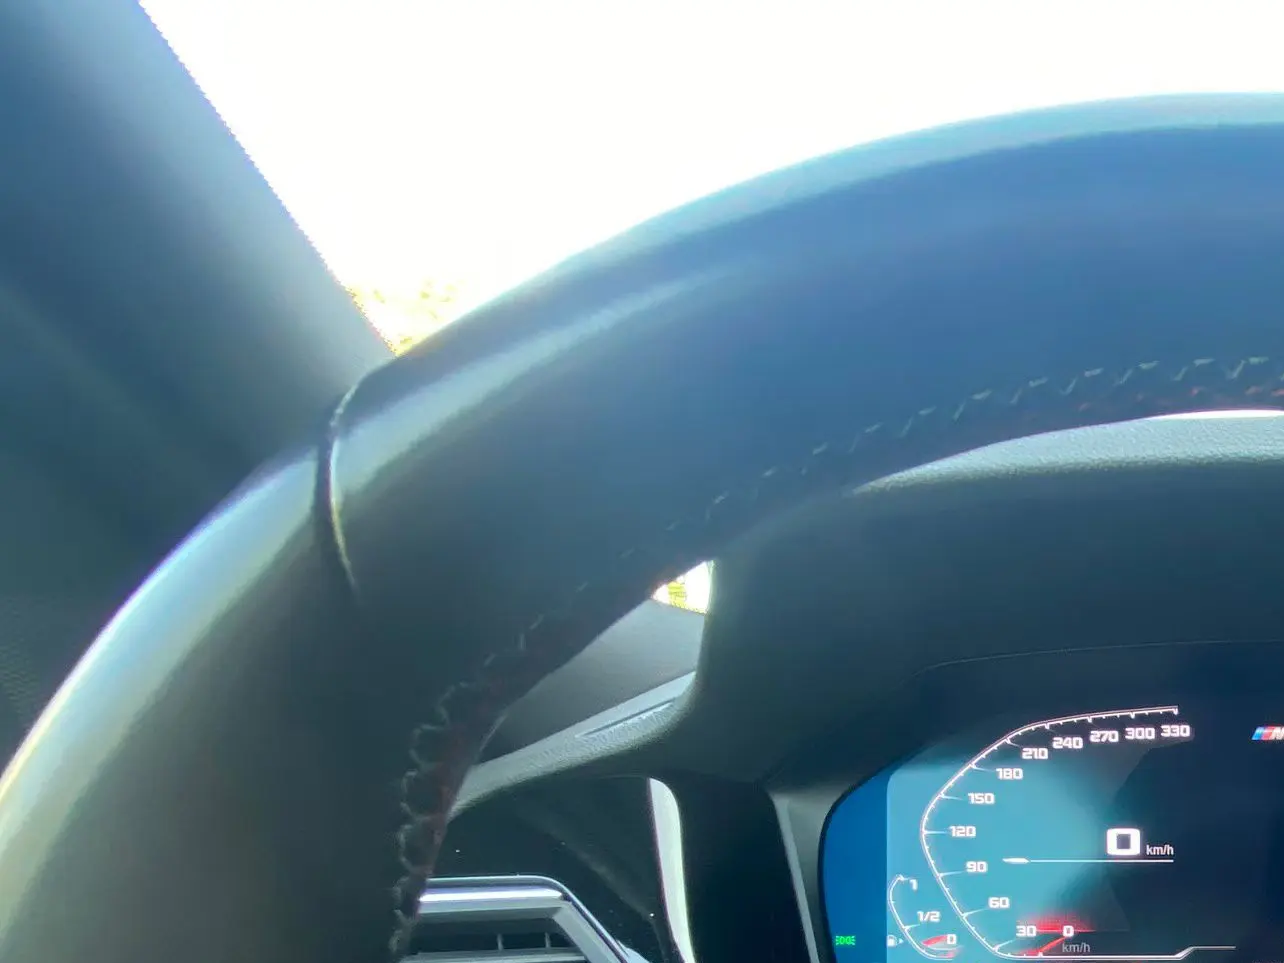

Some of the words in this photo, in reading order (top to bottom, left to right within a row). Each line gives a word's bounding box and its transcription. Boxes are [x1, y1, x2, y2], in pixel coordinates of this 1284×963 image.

[1090, 730, 1119, 742] 270
[1125, 727, 1155, 740] 300
[1161, 725, 1191, 737] 330
[1053, 737, 1083, 749] 240
[1022, 748, 1049, 759] 210
[996, 768, 1023, 780] 180
[968, 793, 995, 804] 150
[950, 826, 976, 837] 120
[1107, 828, 1140, 856] 0
[1146, 844, 1174, 856] km/h
[966, 861, 988, 873] 90
[909, 879, 918, 891] 1
[988, 897, 1010, 908] 60
[917, 911, 940, 922] 1/2
[1016, 925, 1037, 937] 30
[1062, 925, 1074, 937] 0
[946, 933, 957, 945] 0
[1062, 942, 1091, 953] km/h
